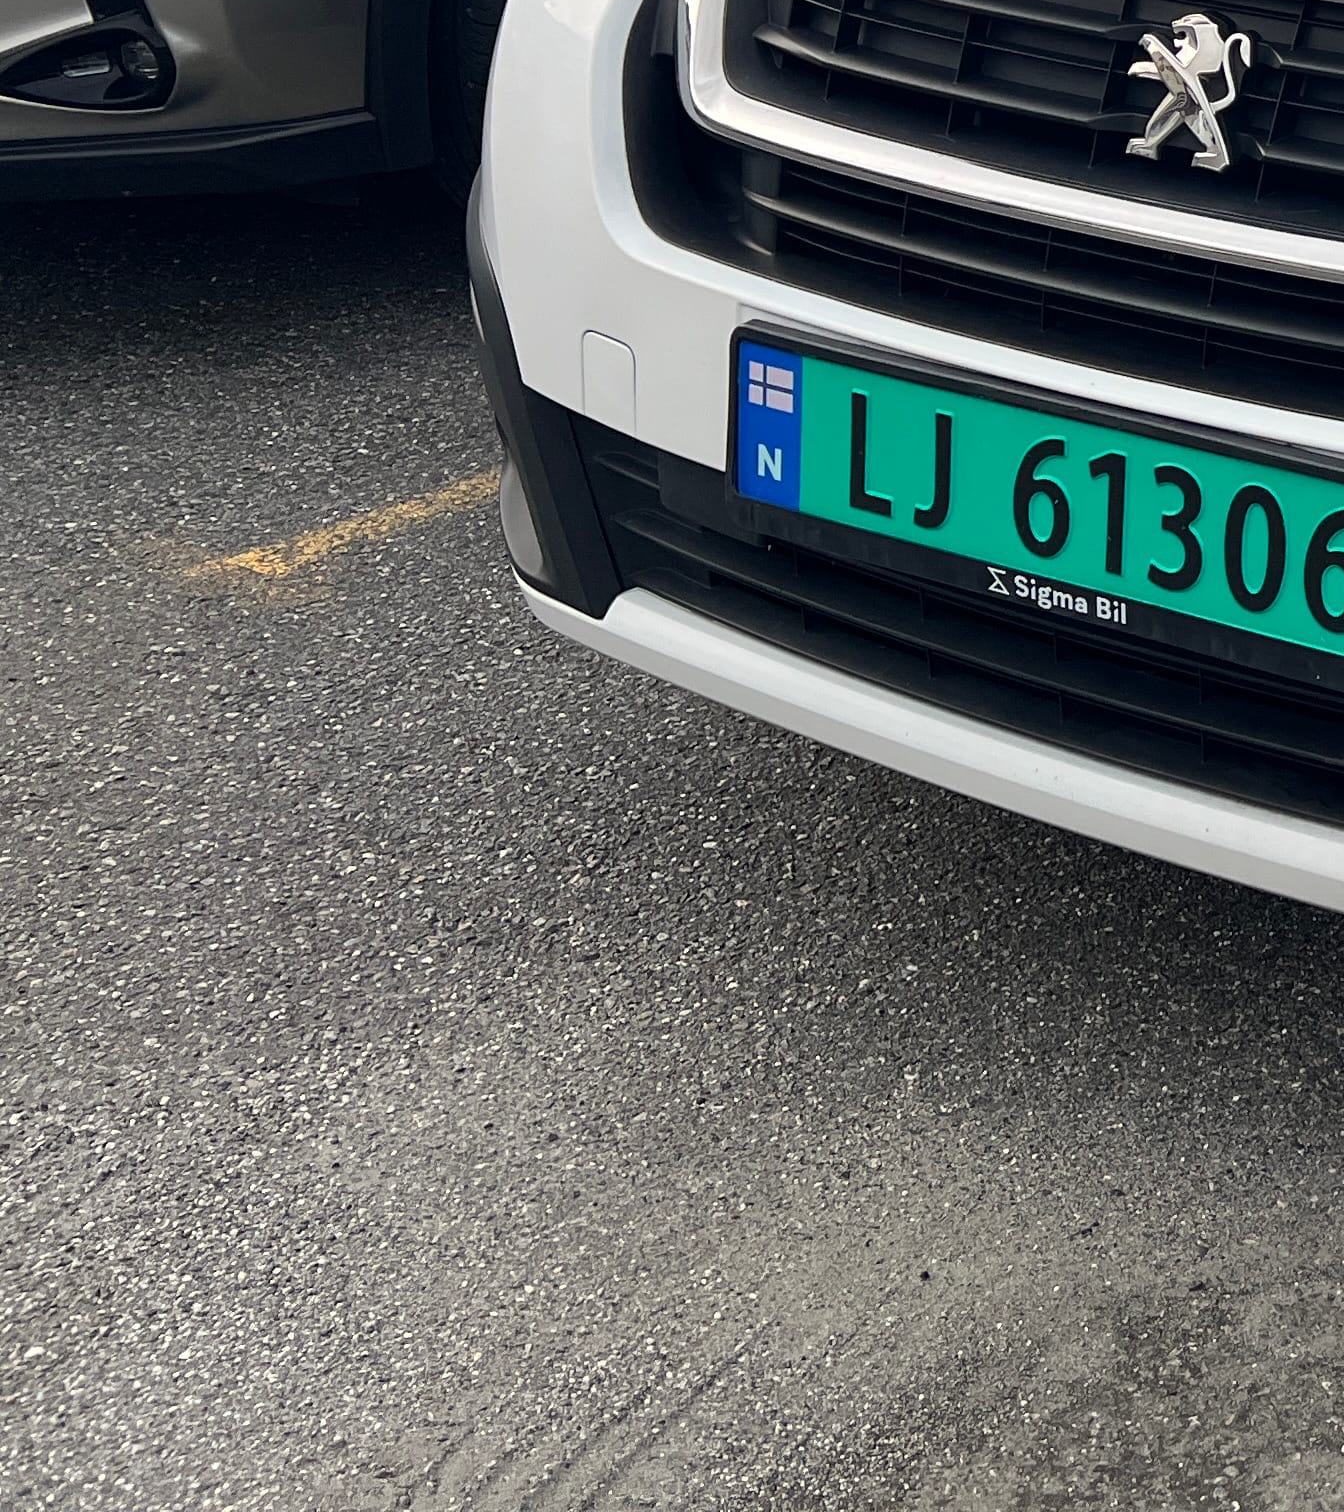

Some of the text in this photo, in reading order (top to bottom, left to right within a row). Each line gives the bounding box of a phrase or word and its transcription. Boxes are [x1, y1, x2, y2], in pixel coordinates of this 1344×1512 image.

[757, 444, 781, 481] N
[850, 391, 953, 528] LJ
[1014, 575, 1127, 625] Sigma Bil
